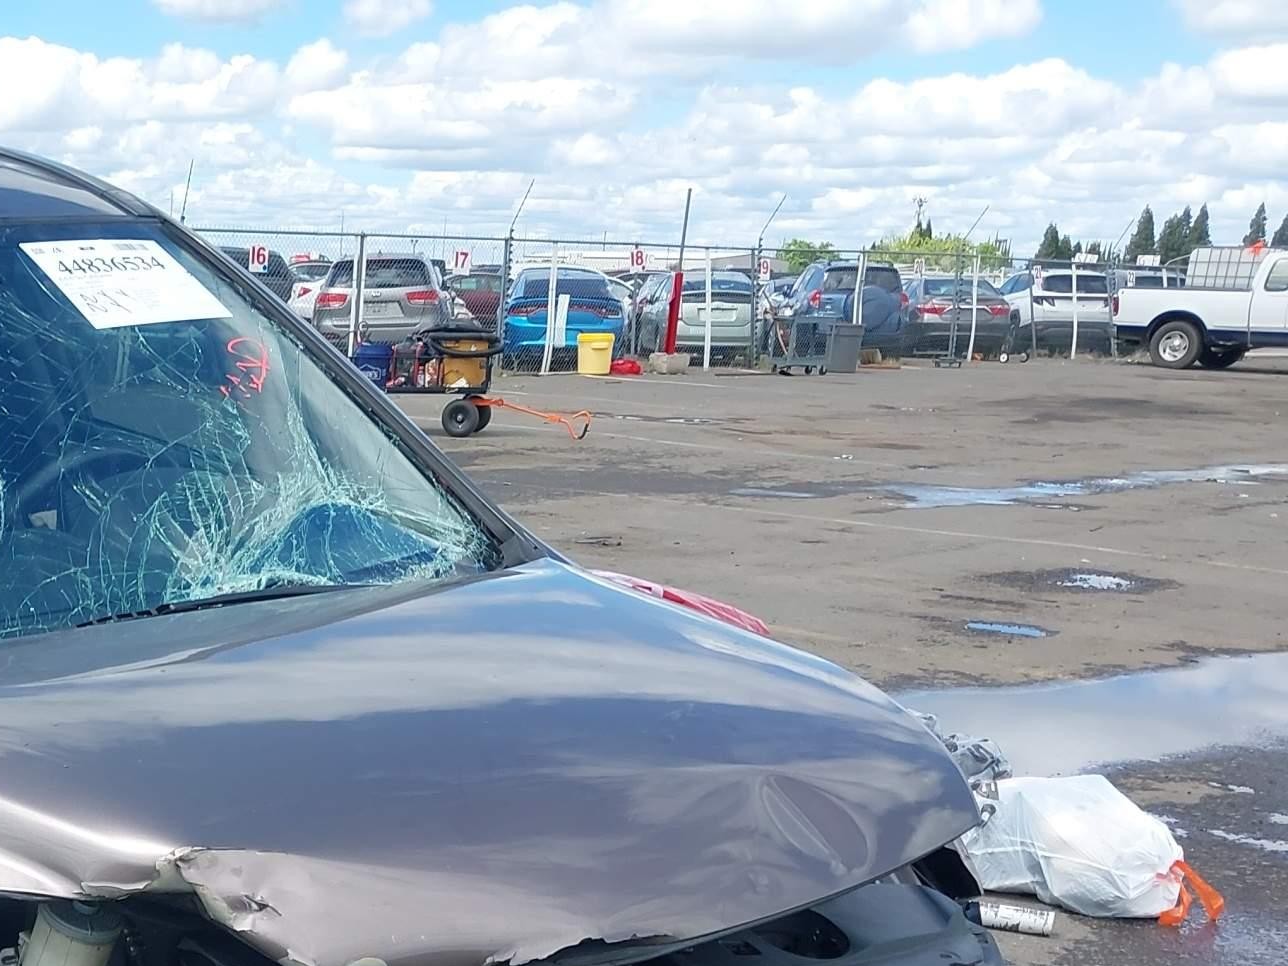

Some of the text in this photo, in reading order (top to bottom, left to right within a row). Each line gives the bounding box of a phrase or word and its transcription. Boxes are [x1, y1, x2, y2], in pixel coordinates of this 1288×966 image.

[251, 246, 266, 265] 16
[454, 252, 469, 267] 17
[631, 251, 644, 266] 18
[58, 257, 165, 274] 44836534
